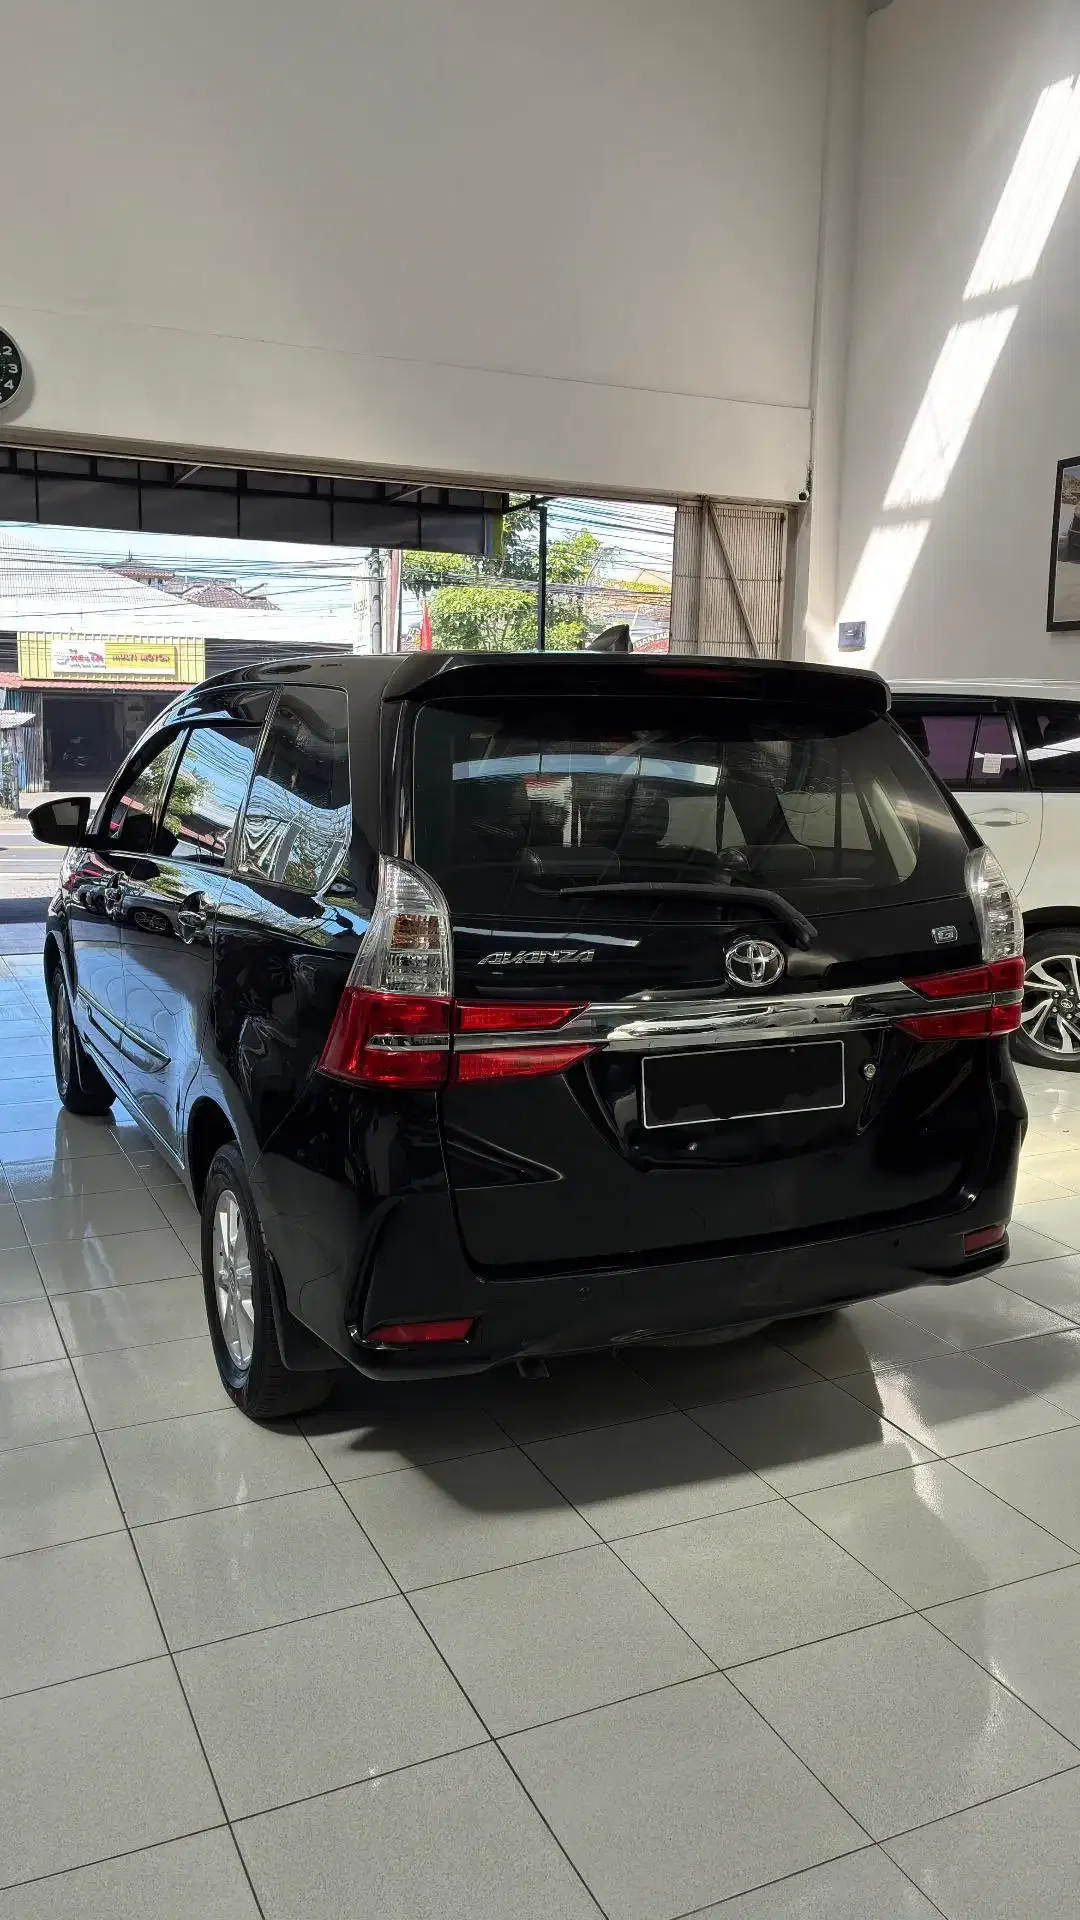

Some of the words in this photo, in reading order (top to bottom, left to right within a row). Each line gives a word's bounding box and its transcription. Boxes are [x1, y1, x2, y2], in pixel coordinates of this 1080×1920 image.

[3, 346, 13, 356] 2
[8, 363, 19, 374] 3
[4, 379, 15, 390] 4
[477, 949, 596, 965] AVANZA
